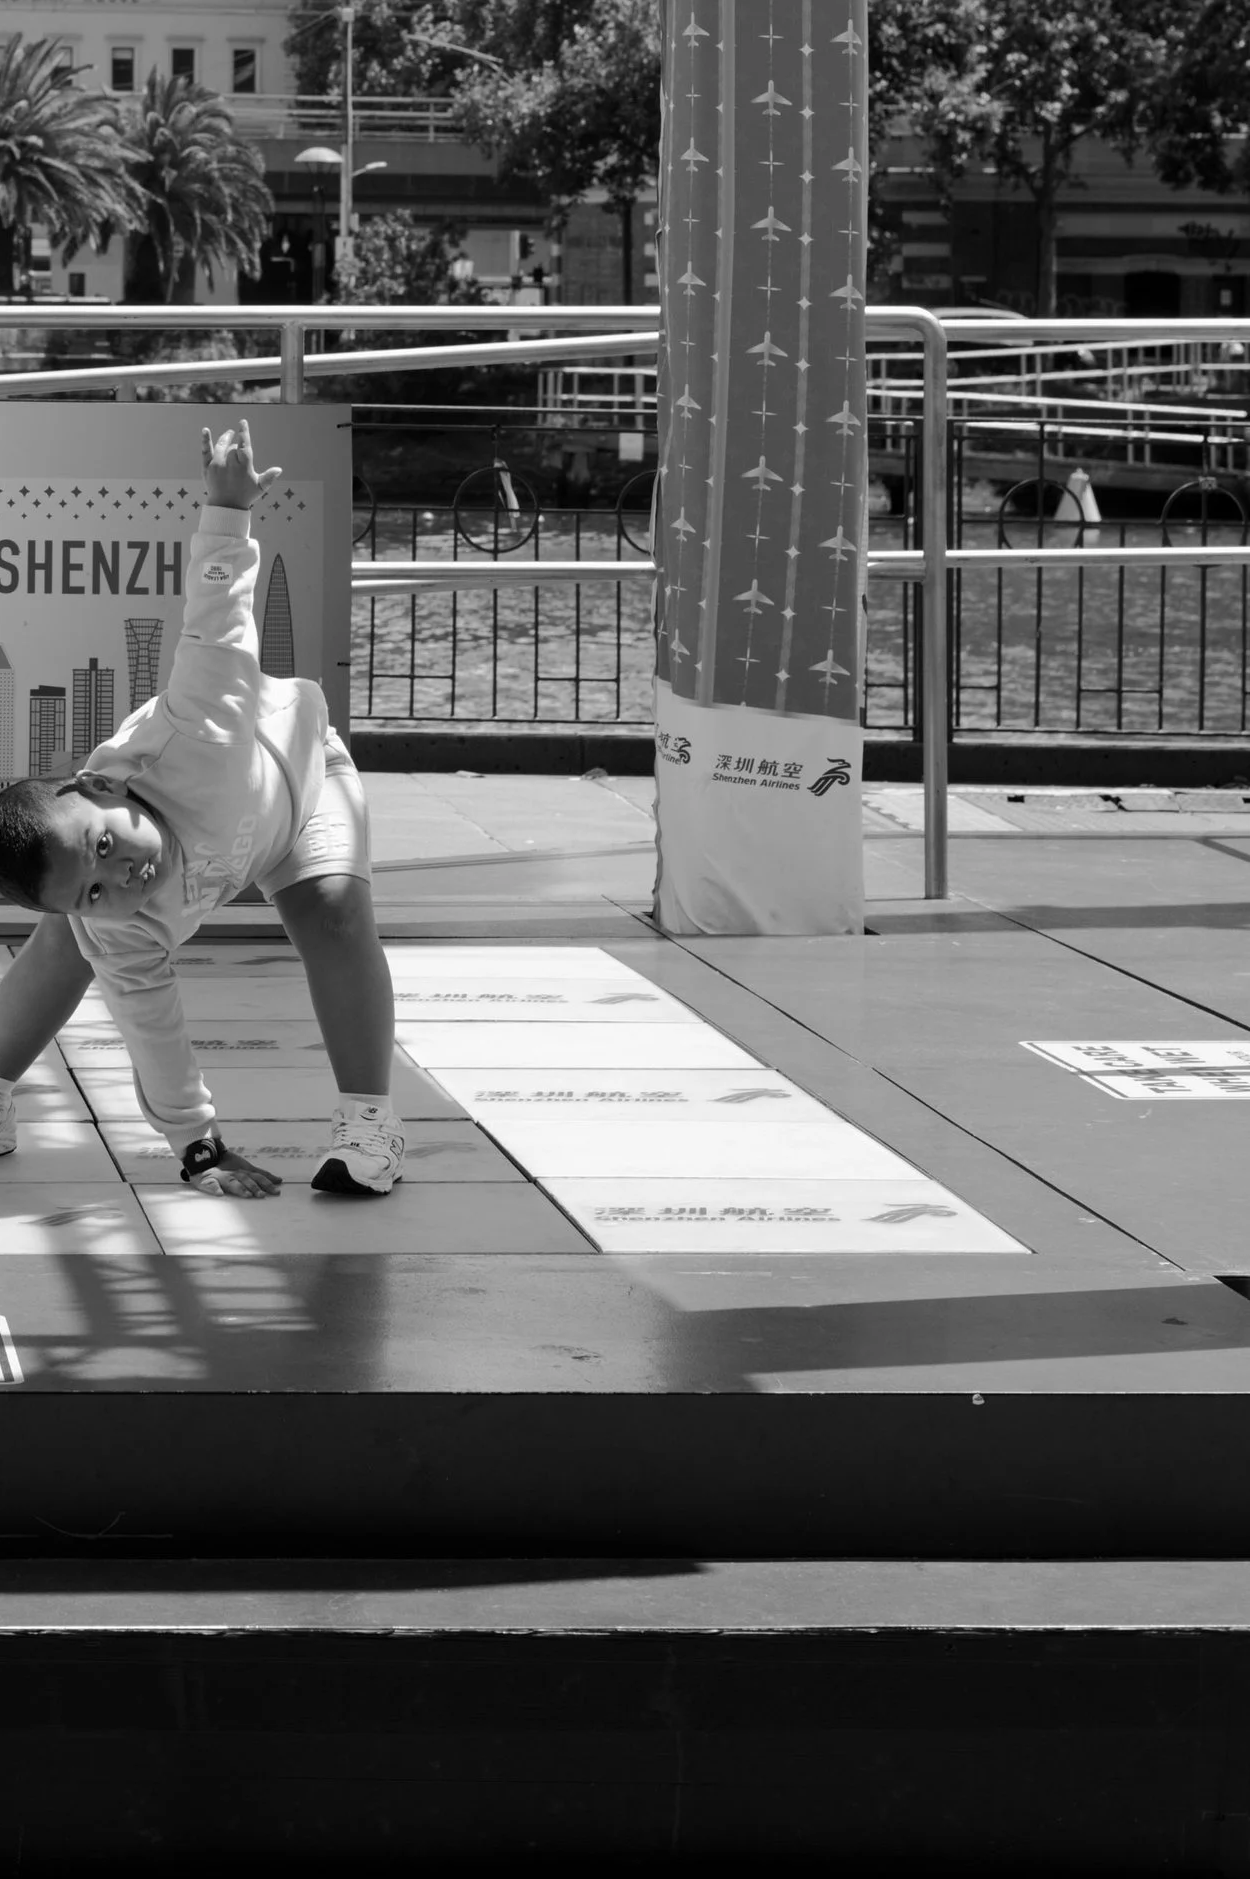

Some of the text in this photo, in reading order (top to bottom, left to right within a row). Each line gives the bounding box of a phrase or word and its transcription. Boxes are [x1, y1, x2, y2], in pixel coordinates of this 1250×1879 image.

[715, 754, 803, 779] 深圳航空
[712, 773, 800, 791] Shenzhen Airlines
